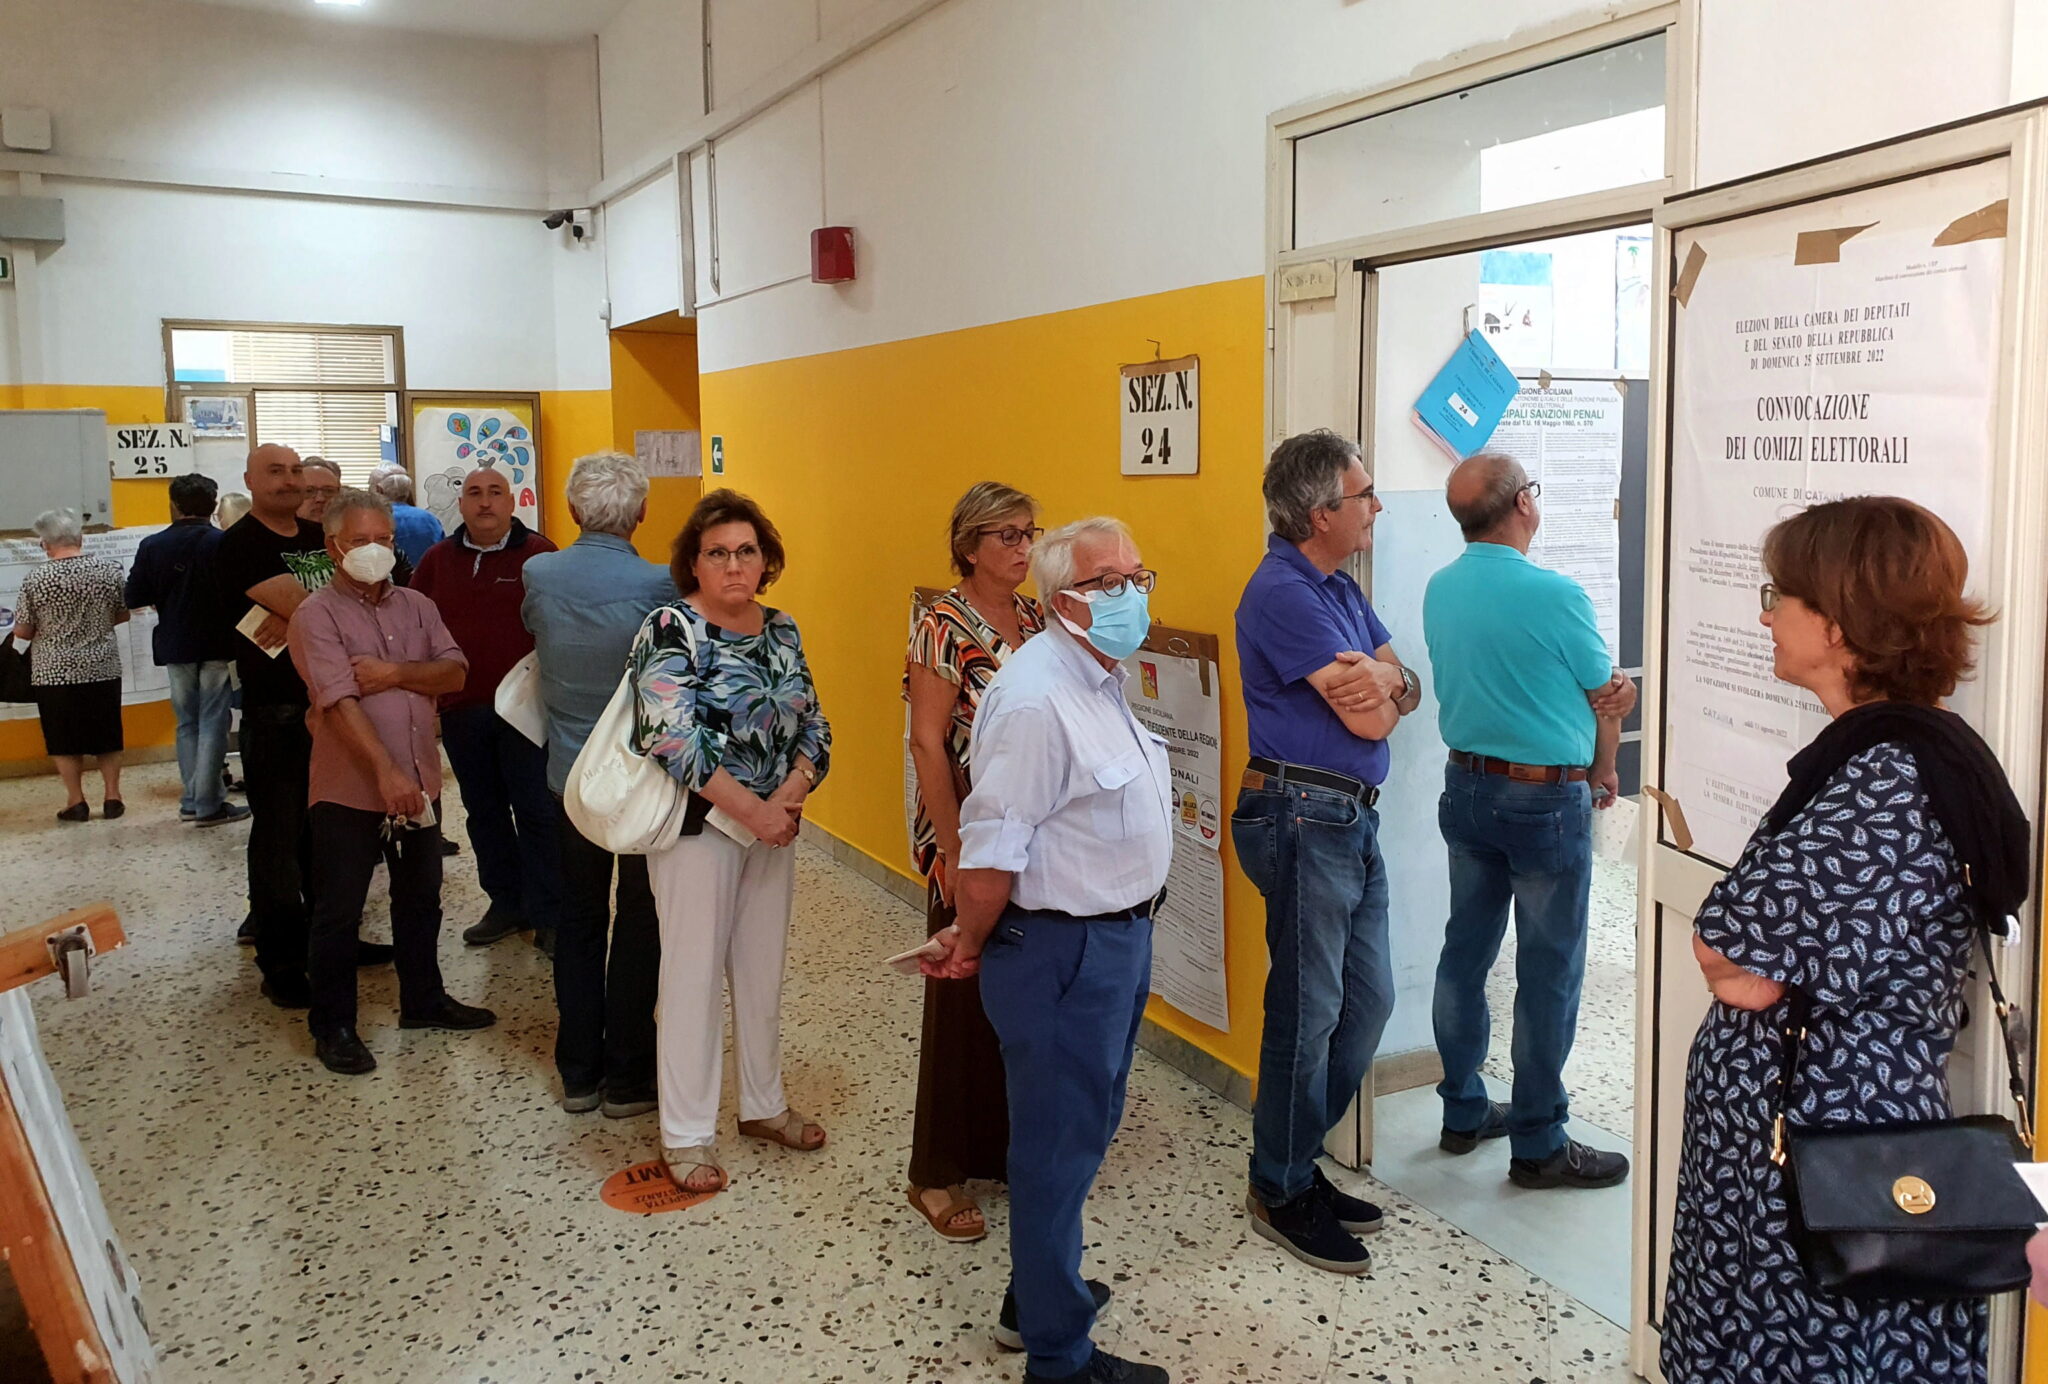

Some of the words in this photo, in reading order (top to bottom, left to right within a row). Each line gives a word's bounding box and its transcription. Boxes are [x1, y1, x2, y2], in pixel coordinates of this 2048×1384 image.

[1736, 318, 1769, 334] ELEZIONI
[1774, 315, 1799, 330] DELLA
[1804, 311, 1838, 327] CAMERA
[1844, 307, 1859, 323] DEI
[1864, 302, 1910, 321] DEPUTATI
[1745, 340, 1750, 352] E
[1753, 338, 1767, 351] DEL
[1772, 335, 1802, 350] SENATO
[1807, 333, 1833, 347] DELLA
[1838, 327, 1894, 345] REPUBBLICA
[1751, 358, 1758, 370] DI
[1762, 355, 1799, 369] DOMENICA
[1804, 354, 1811, 367] 25
[1816, 351, 1861, 366] SETTEMBRE
[1867, 349, 1884, 363] 2022
[1129, 373, 1172, 413] SEZ.
[1176, 370, 1193, 410] N.
[1459, 404, 1468, 415] 24
[1530, 409, 1571, 419] SANZIONI
[1574, 409, 1604, 419] PENALI
[1757, 393, 1870, 422] CONVOCAZIONE
[117, 429, 165, 448] SEZ.
[169, 429, 188, 448] N.
[1141, 427, 1171, 464] 24
[1725, 436, 1746, 460] DEI
[1754, 436, 1803, 461] COMIZI
[1810, 436, 1909, 464] ELETTORALI
[134, 456, 168, 475] 25
[1753, 486, 1788, 499] COMUNE
[1793, 488, 1802, 500] DI
[1696, 675, 1702, 683] LA
[1703, 676, 1730, 691] VOTAZIONE
[1765, 691, 1794, 708] DOMENICA
[1178, 728, 1198, 742] DELLA
[1187, 748, 1199, 758] 2022
[1703, 789, 1710, 799] LA
[625, 1166, 663, 1185] MT
